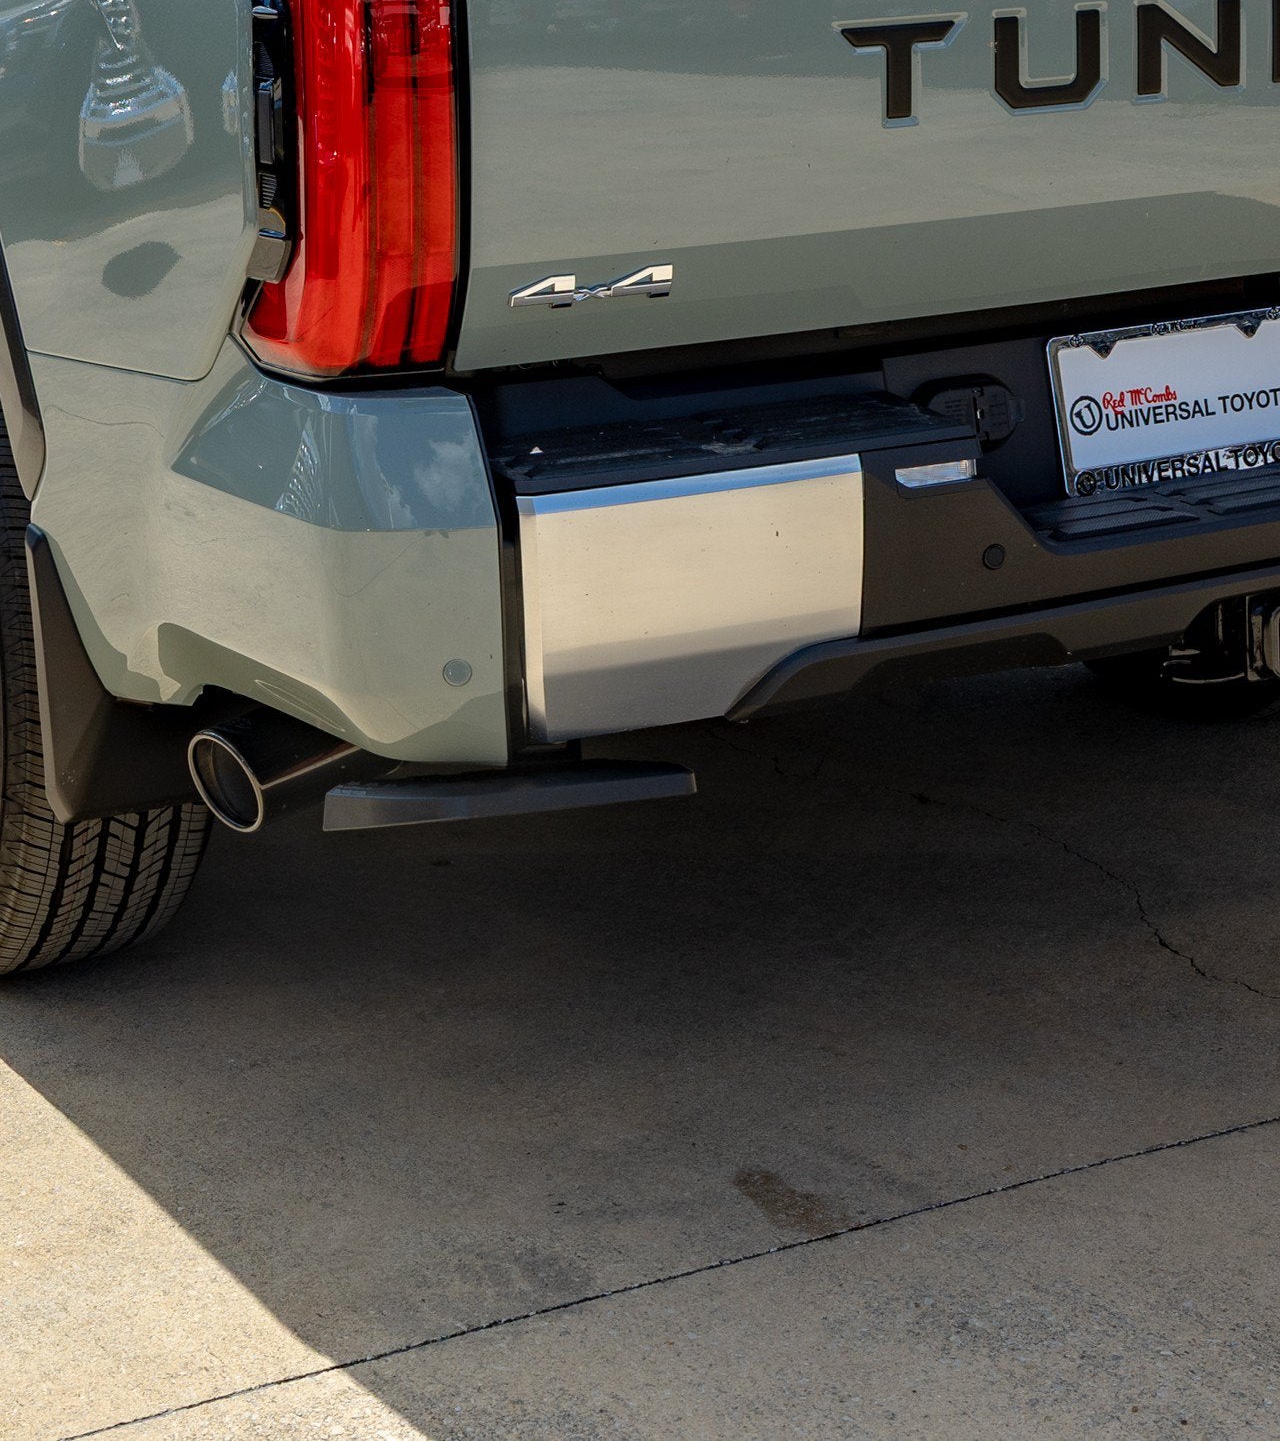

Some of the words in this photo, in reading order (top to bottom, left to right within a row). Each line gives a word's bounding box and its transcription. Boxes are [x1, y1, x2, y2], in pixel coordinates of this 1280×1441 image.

[1102, 390, 1125, 416] Red
[1105, 398, 1216, 431] UNIVERSAL
[1103, 451, 1228, 490] UNIVERSAL
